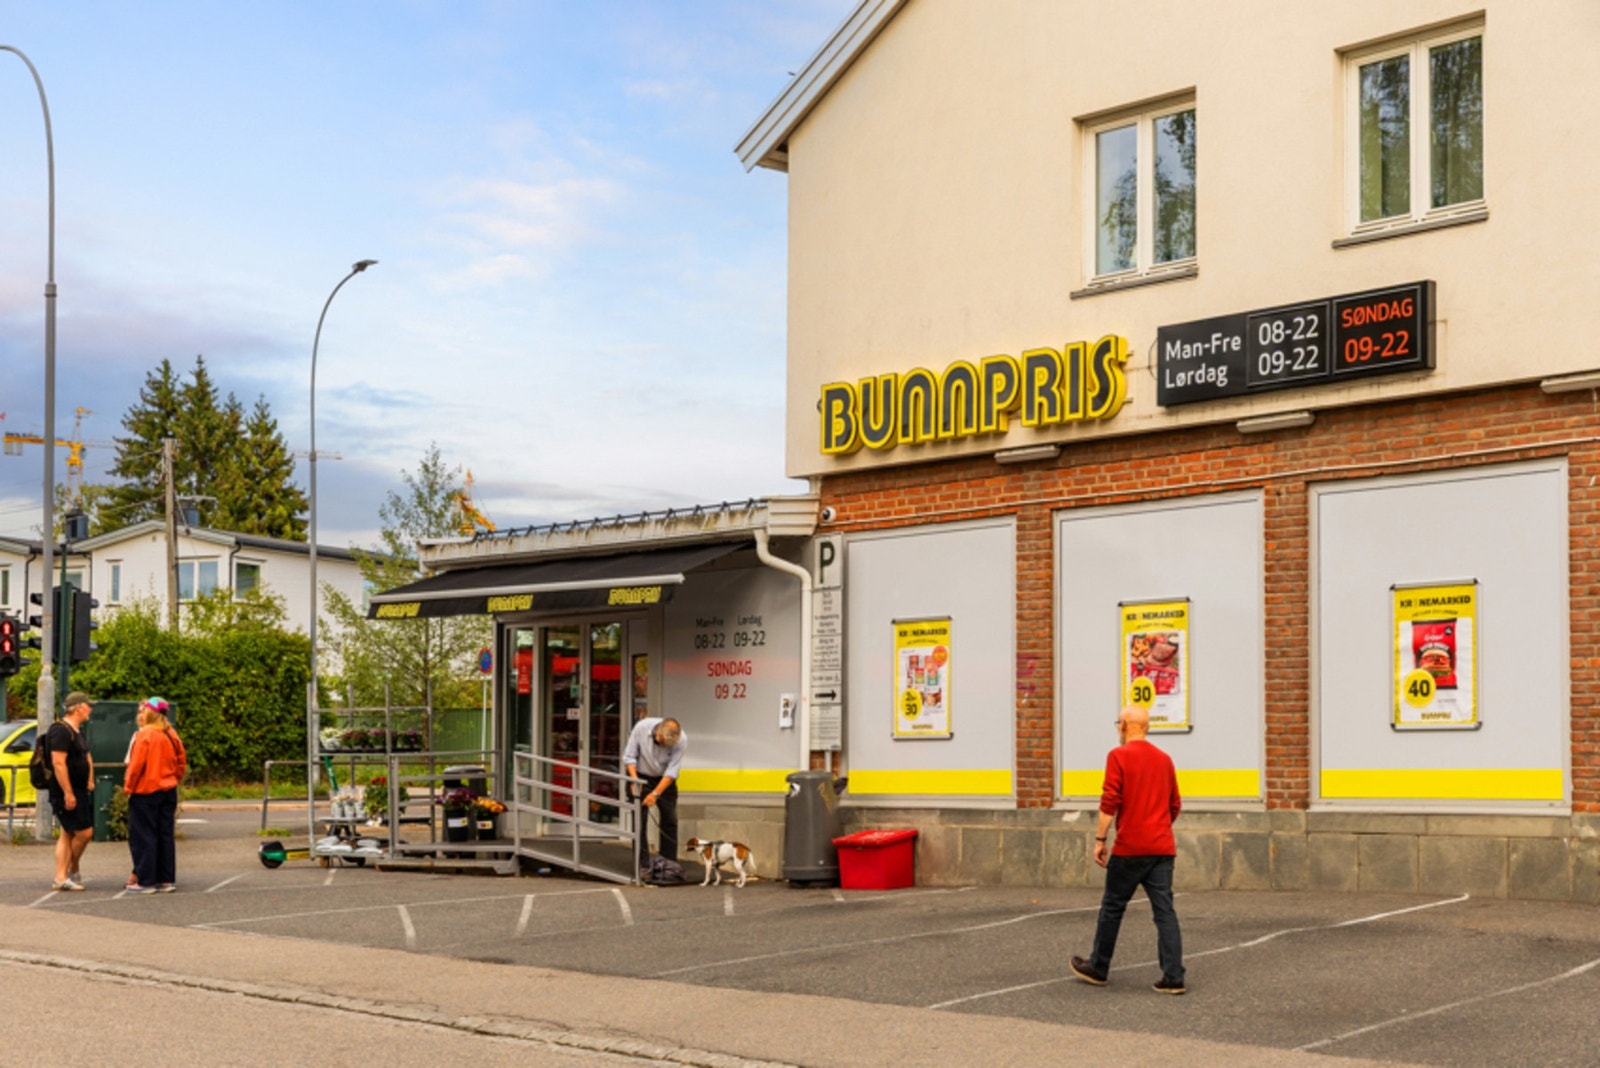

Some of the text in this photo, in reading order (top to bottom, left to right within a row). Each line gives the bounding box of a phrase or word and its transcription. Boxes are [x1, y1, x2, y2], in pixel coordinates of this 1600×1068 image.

[1341, 297, 1413, 328] SØNDAG
[1165, 314, 1319, 361] Man-Fre 08-22
[1344, 330, 1409, 362] 09-22
[1165, 345, 1319, 388] Lørdag 09-22
[820, 334, 1125, 454] BUNNPRIS
[819, 541, 834, 584] P
[694, 630, 766, 650] 08-22 09-22
[707, 660, 752, 677] SØNDAG
[1133, 686, 1151, 703] 30
[1408, 679, 1430, 697] 40
